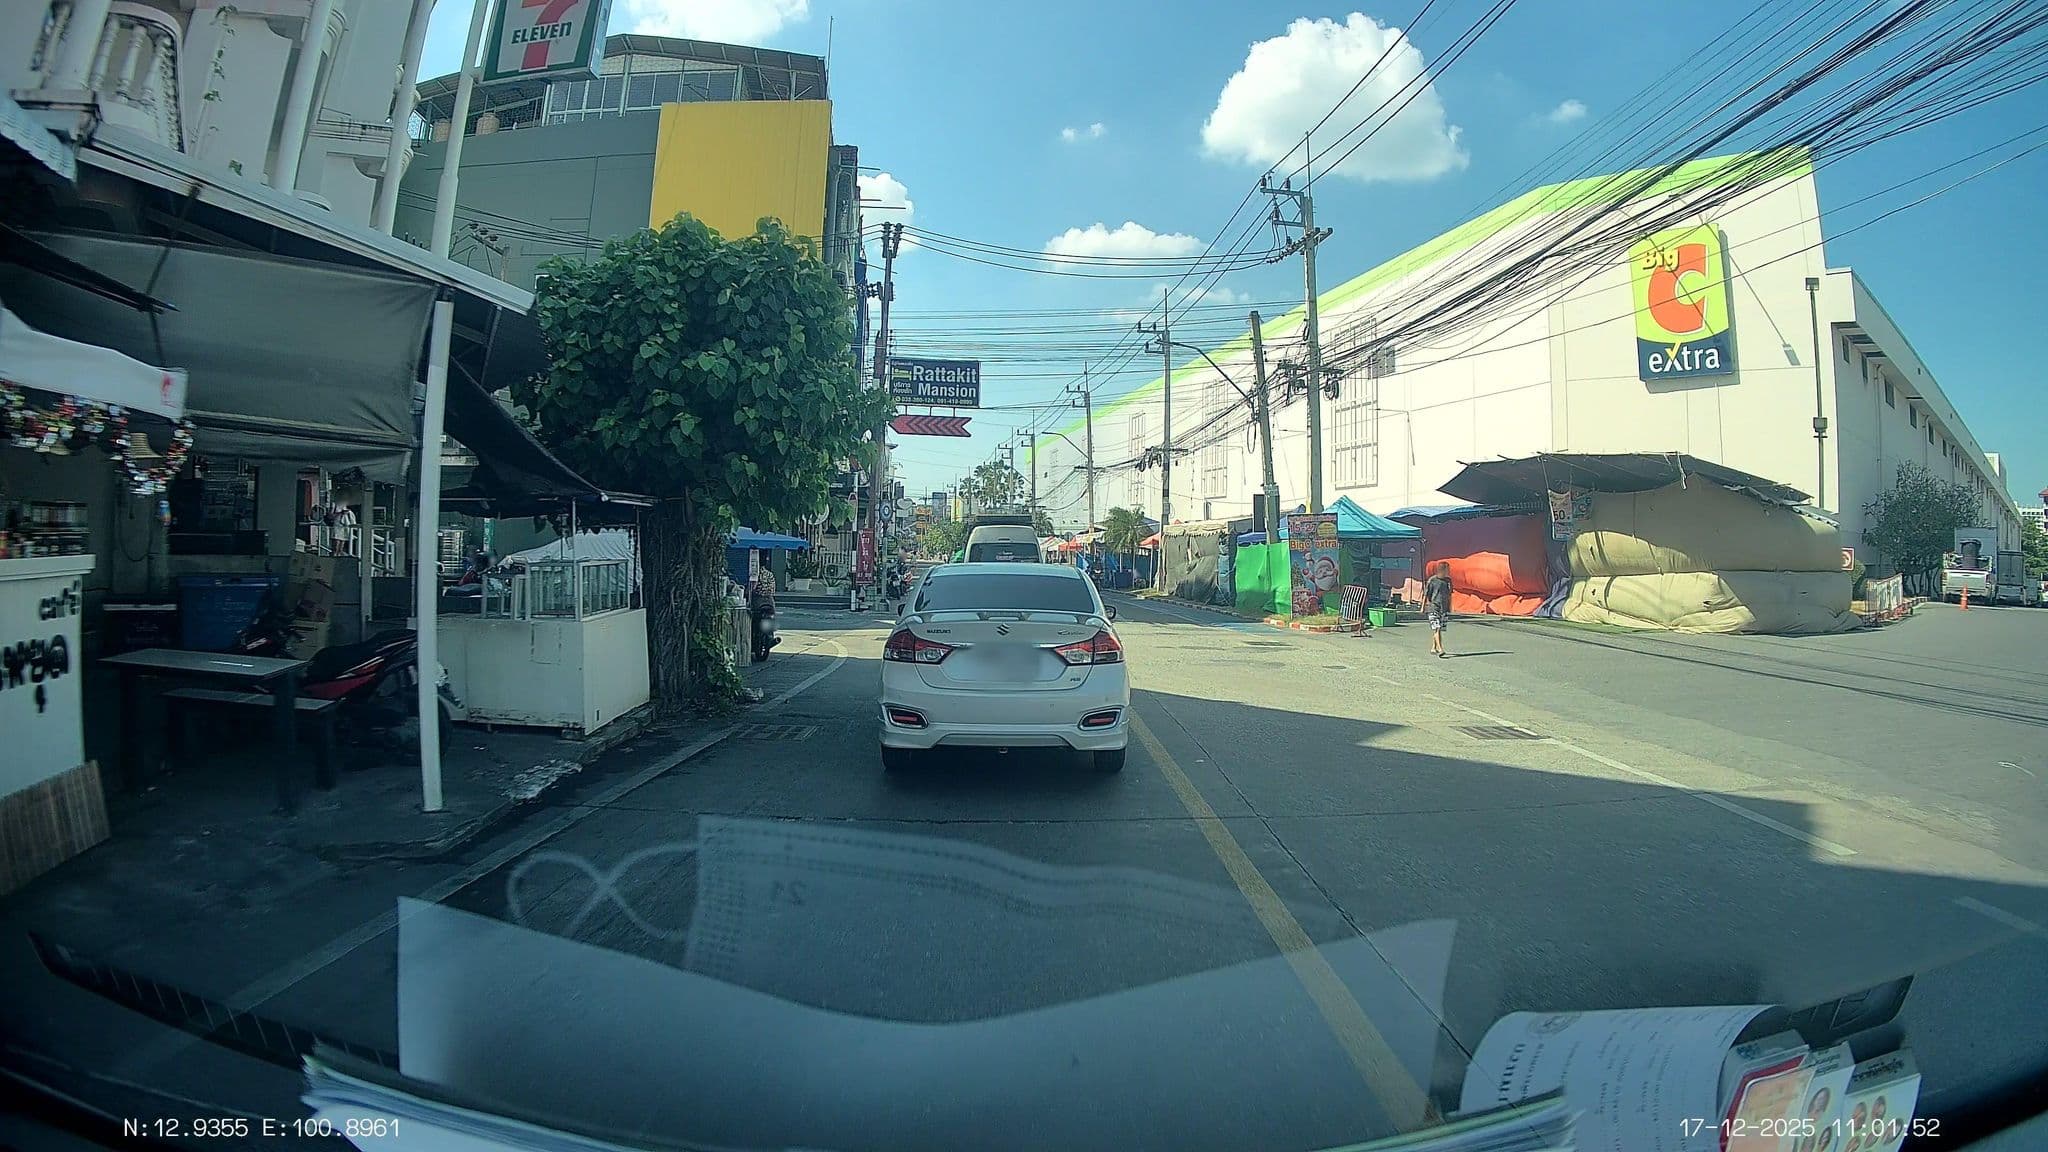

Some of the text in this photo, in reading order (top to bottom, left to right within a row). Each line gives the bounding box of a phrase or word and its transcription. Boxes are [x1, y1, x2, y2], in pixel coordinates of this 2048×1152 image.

[519, 0, 579, 71] 7
[1641, 247, 1680, 273] Big
[1647, 243, 1709, 335] C
[1648, 341, 1721, 373] extra
[912, 365, 977, 384] Rattakit
[918, 383, 976, 398] Mansion
[1315, 540, 1338, 548] extra
